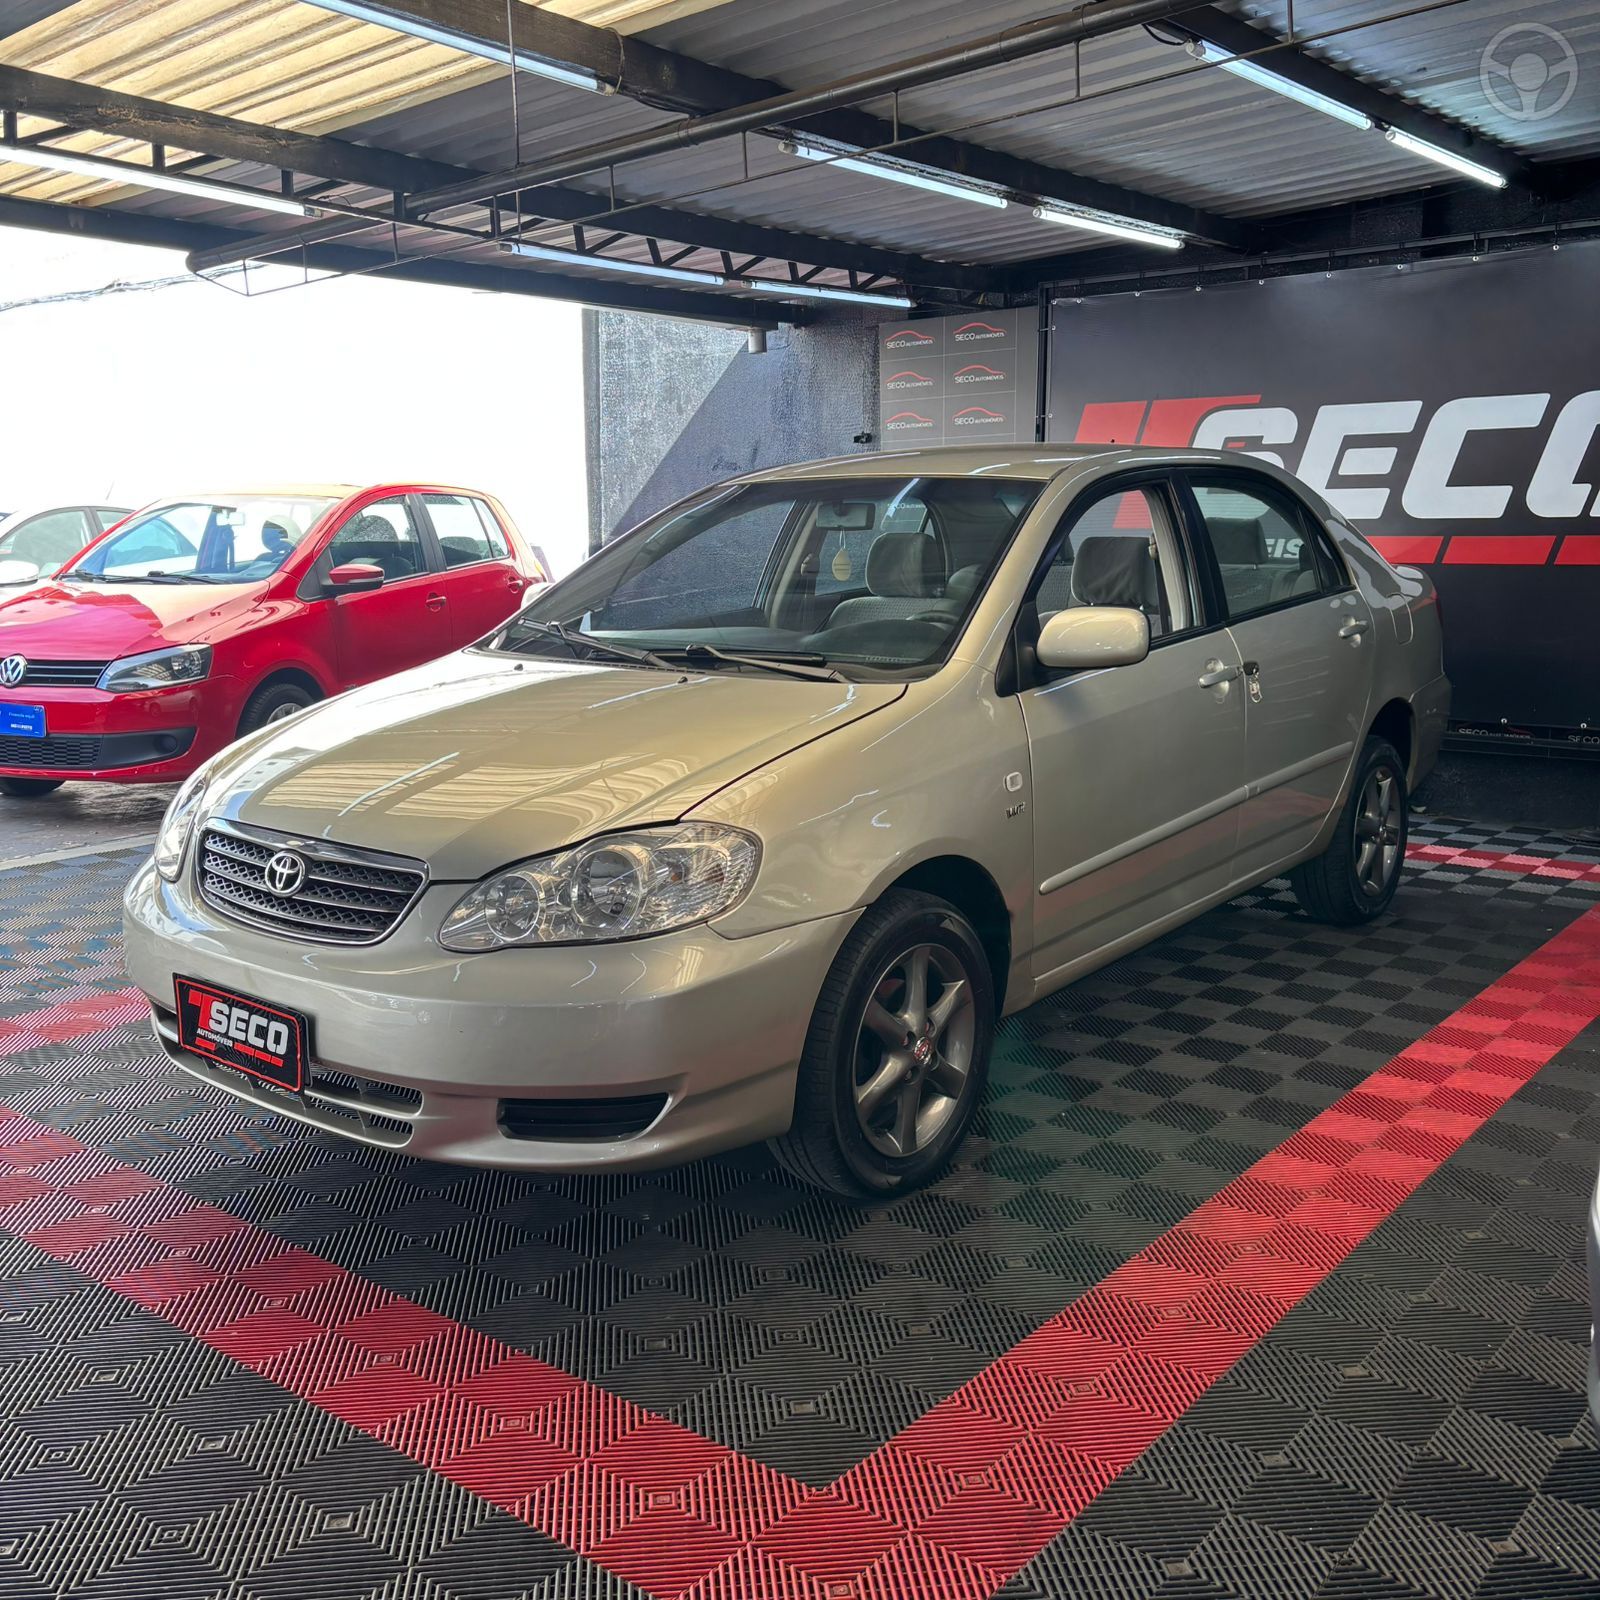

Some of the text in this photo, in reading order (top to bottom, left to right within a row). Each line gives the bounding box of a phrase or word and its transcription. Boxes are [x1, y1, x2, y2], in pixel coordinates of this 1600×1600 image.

[955, 333, 975, 341] SECO
[887, 340, 905, 349] SECO
[955, 375, 974, 383] SECO
[887, 381, 905, 390] SECO
[954, 417, 974, 425] SECO
[887, 422, 905, 430] SECO
[208, 1000, 289, 1055] SECO
